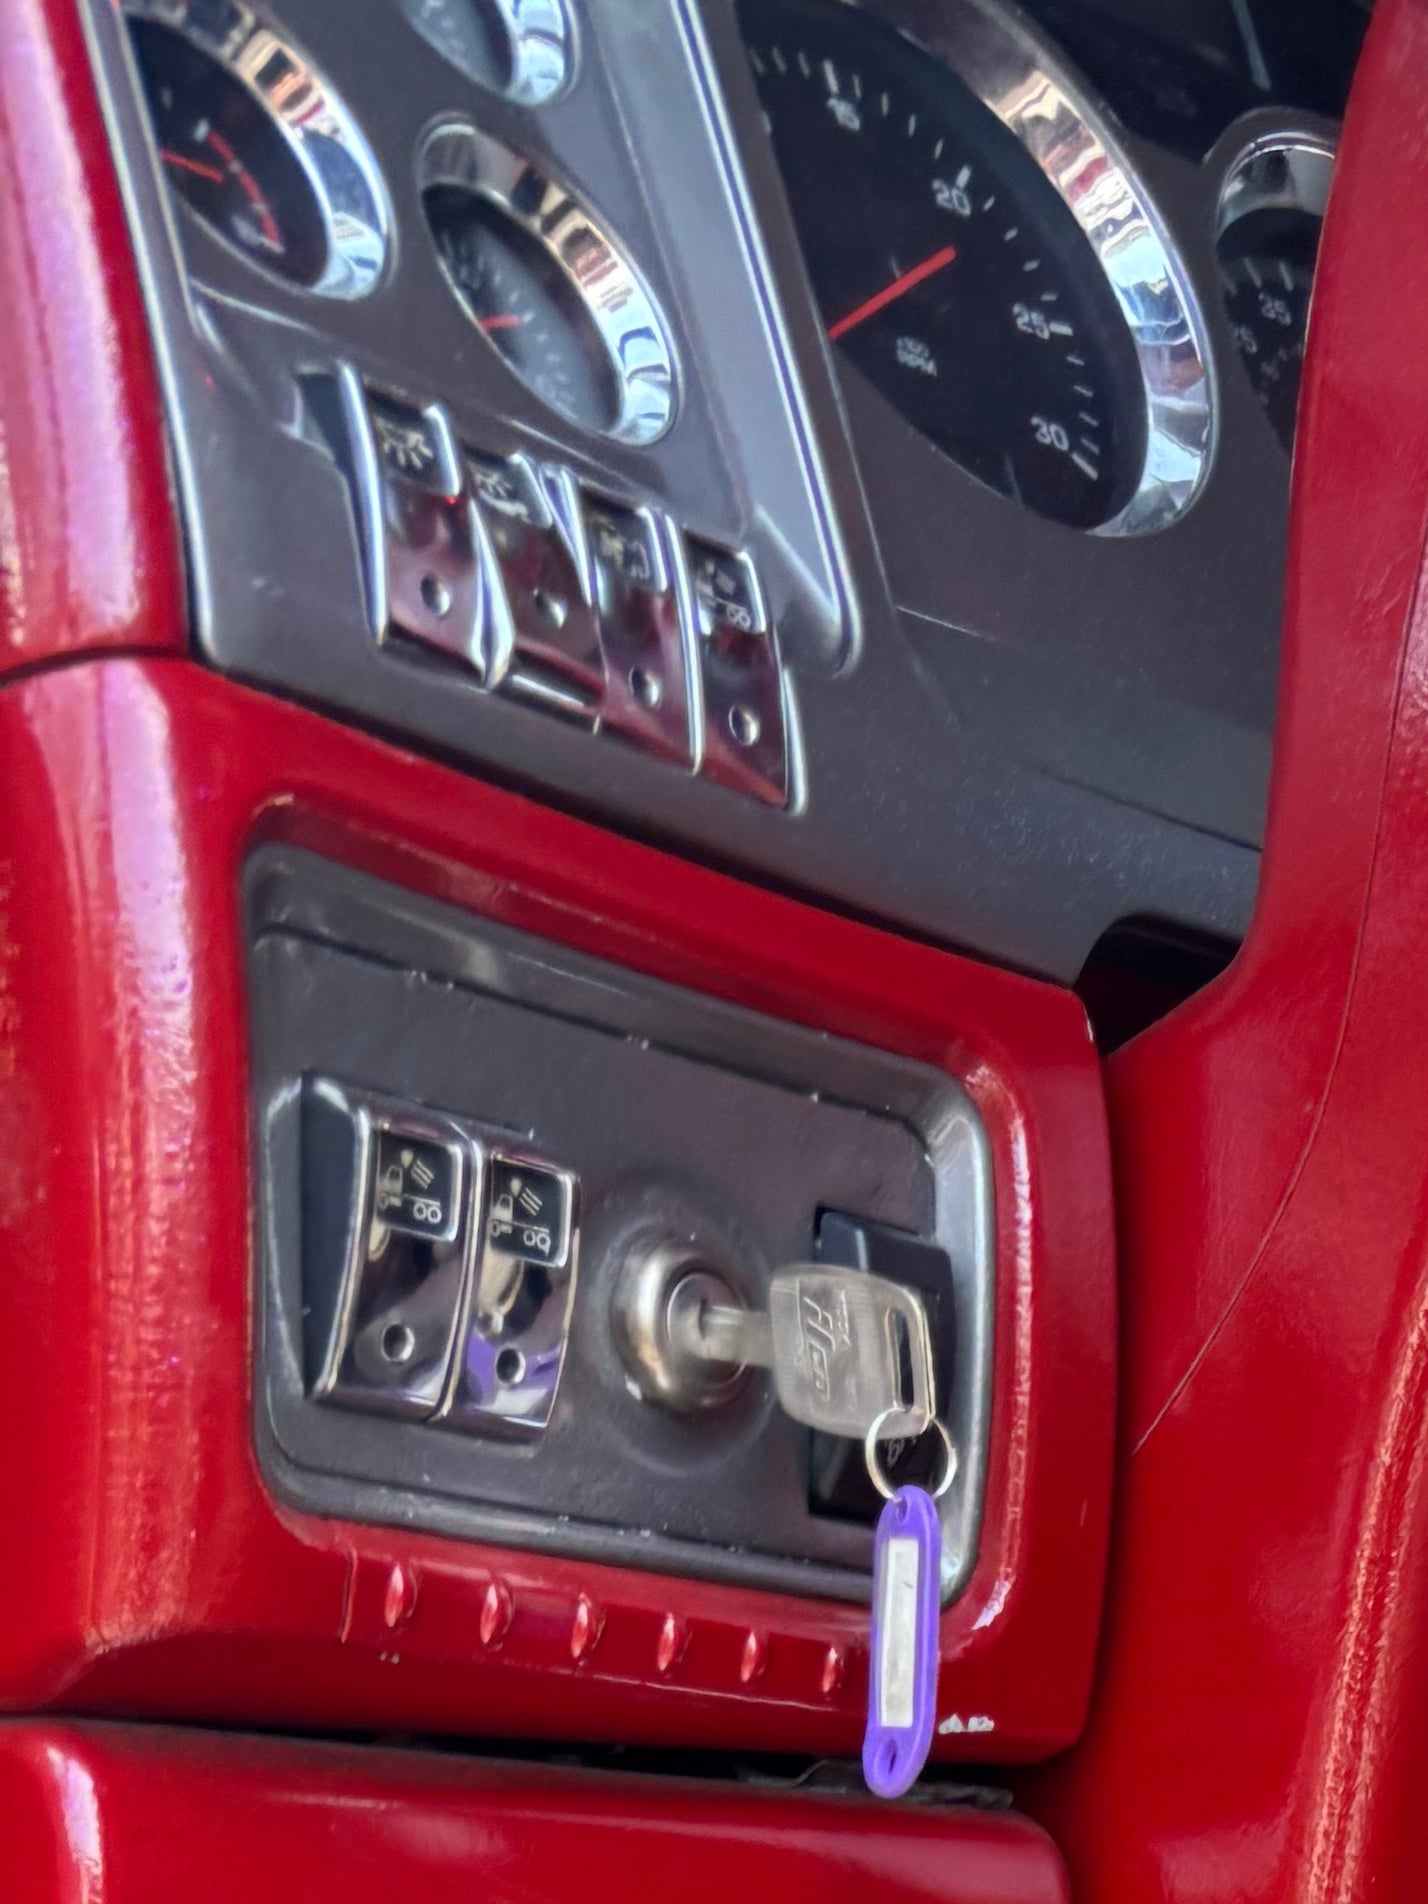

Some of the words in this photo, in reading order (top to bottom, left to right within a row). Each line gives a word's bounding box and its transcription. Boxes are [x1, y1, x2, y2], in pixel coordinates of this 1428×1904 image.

[933, 178, 971, 217] 20
[1012, 302, 1051, 340] 25
[1030, 415, 1069, 451] 30
